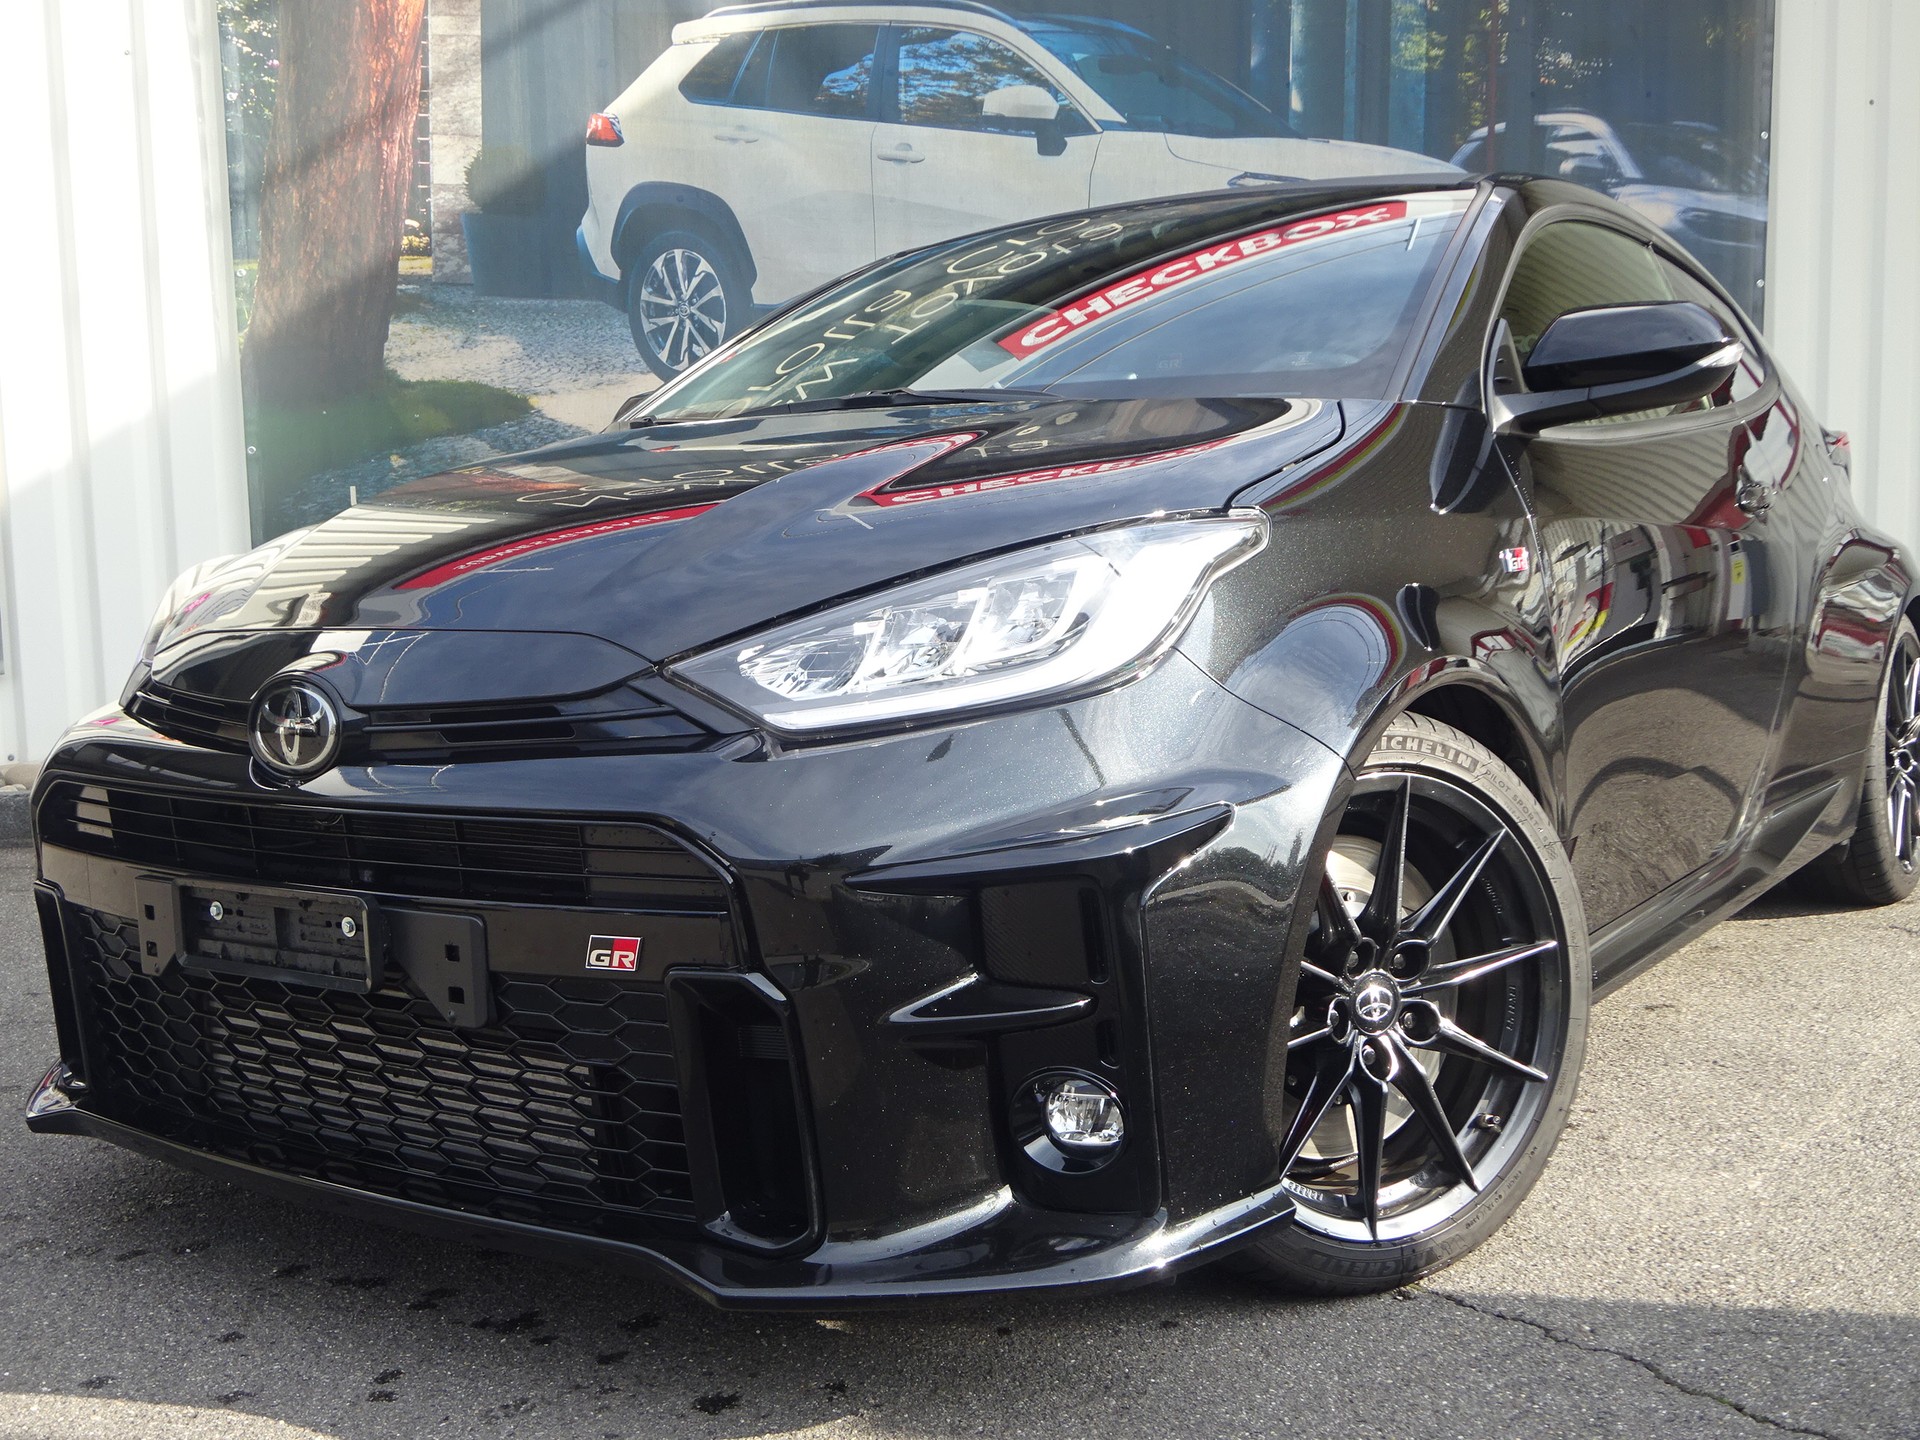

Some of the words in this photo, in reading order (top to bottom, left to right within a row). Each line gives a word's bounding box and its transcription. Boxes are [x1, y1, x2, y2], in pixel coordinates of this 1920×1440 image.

[1020, 205, 1391, 348] CHECKBOX
[1373, 736, 1473, 768] ICHELIN
[1485, 768, 1511, 793] PILOT
[1512, 794, 1540, 826] SPORT
[589, 948, 635, 968] GR
